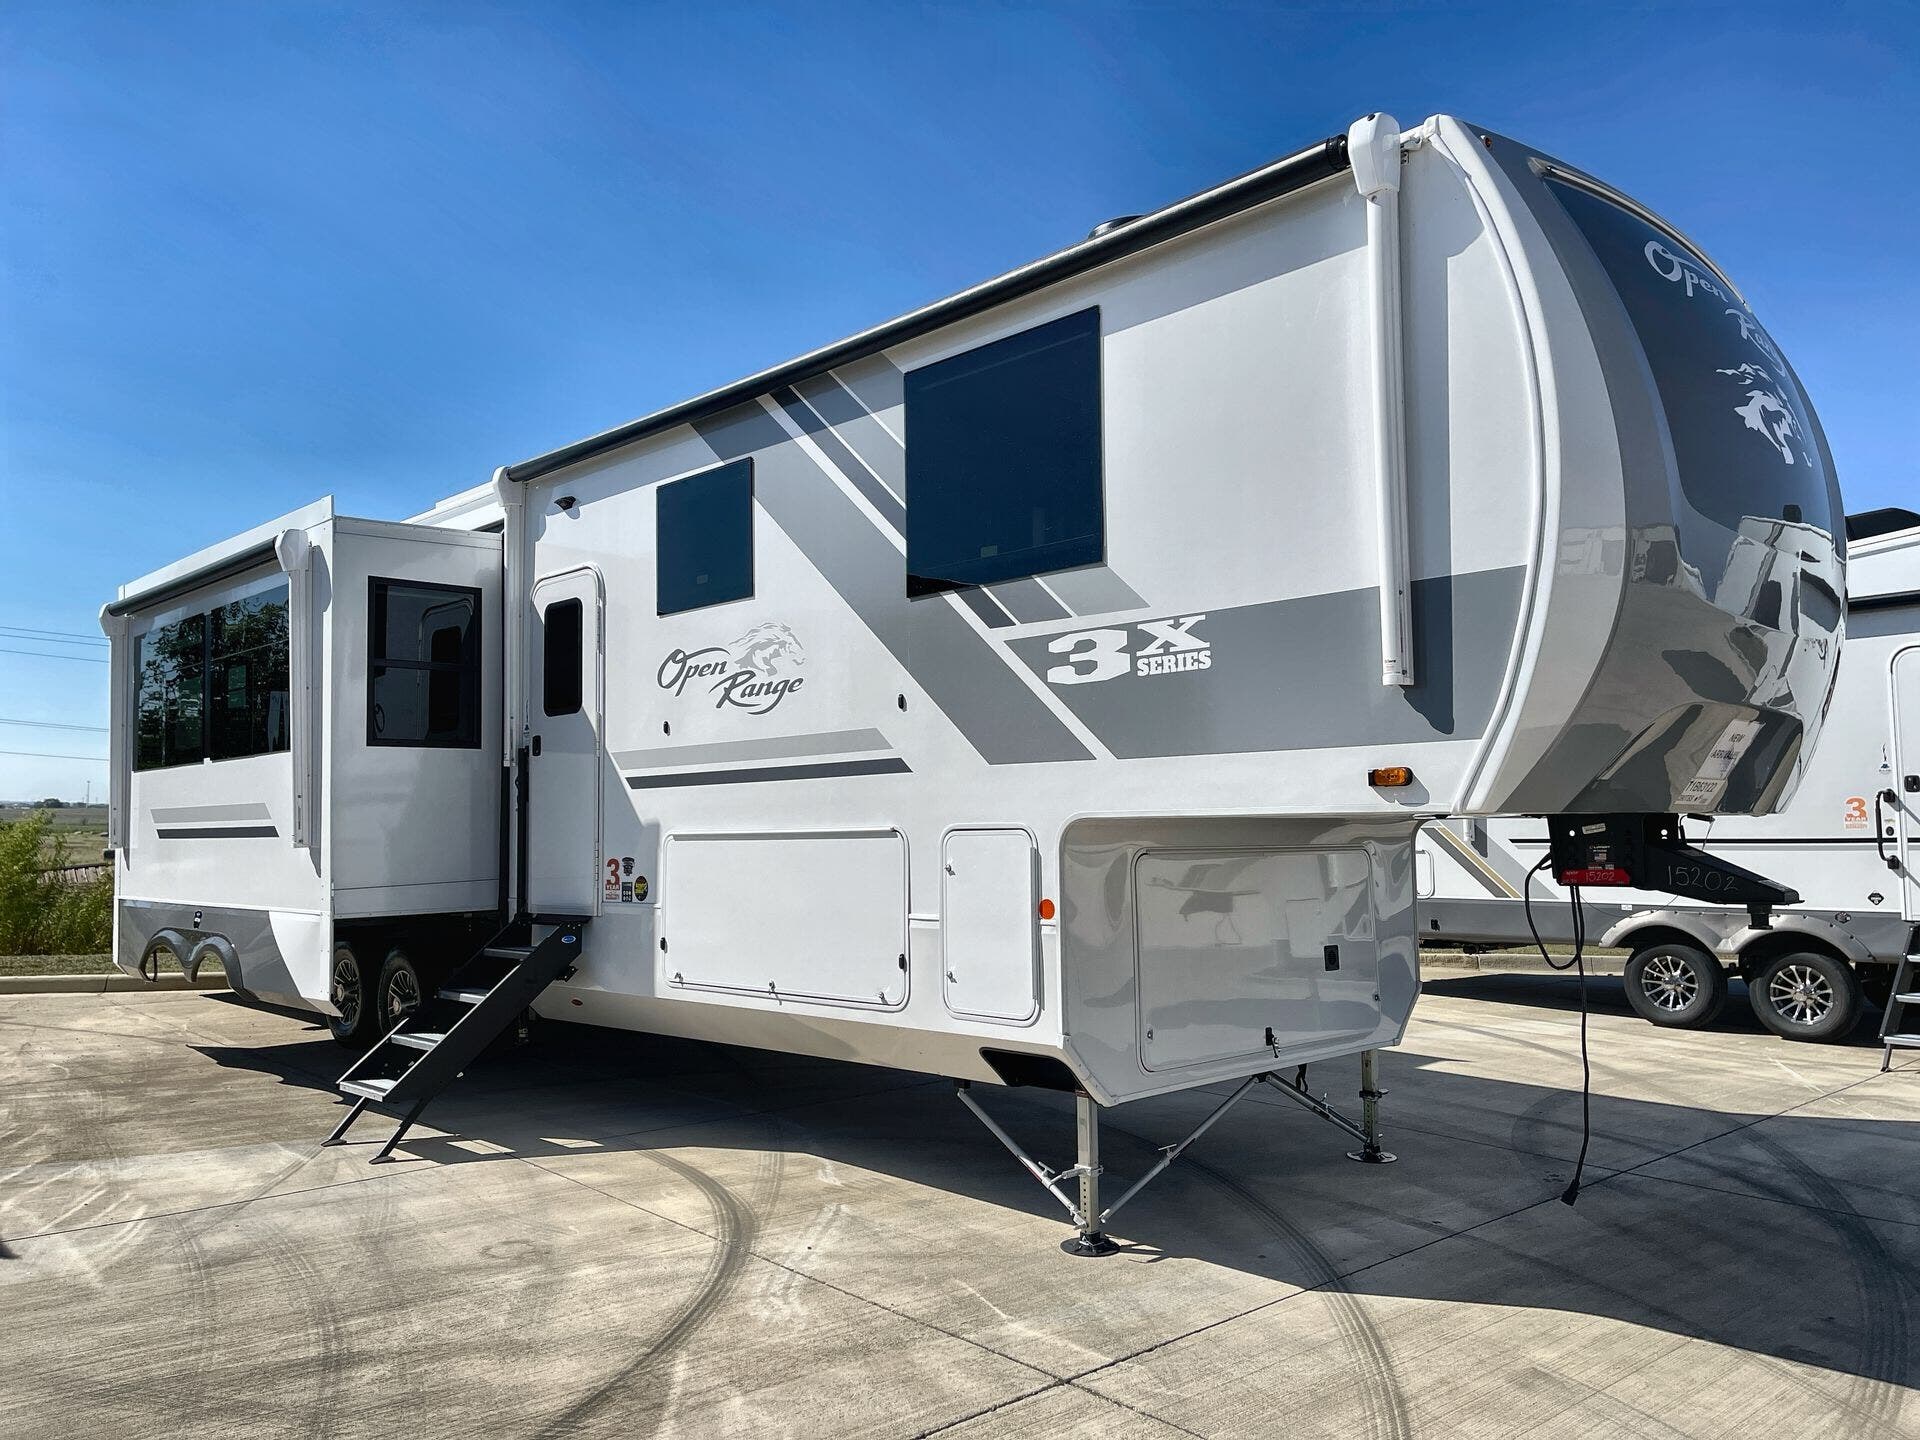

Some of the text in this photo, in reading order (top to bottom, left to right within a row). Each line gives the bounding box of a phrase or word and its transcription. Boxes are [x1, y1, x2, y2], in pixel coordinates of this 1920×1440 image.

[1644, 240, 1729, 302] Open
[1725, 308, 1785, 377] Rag
[657, 647, 731, 697] Open
[1136, 650, 1212, 677] SERIES
[708, 669, 804, 715] Range
[1845, 797, 1867, 818] 3
[606, 858, 621, 885] 3
[1586, 871, 1615, 883] 15202
[1668, 865, 1738, 891] 15202
